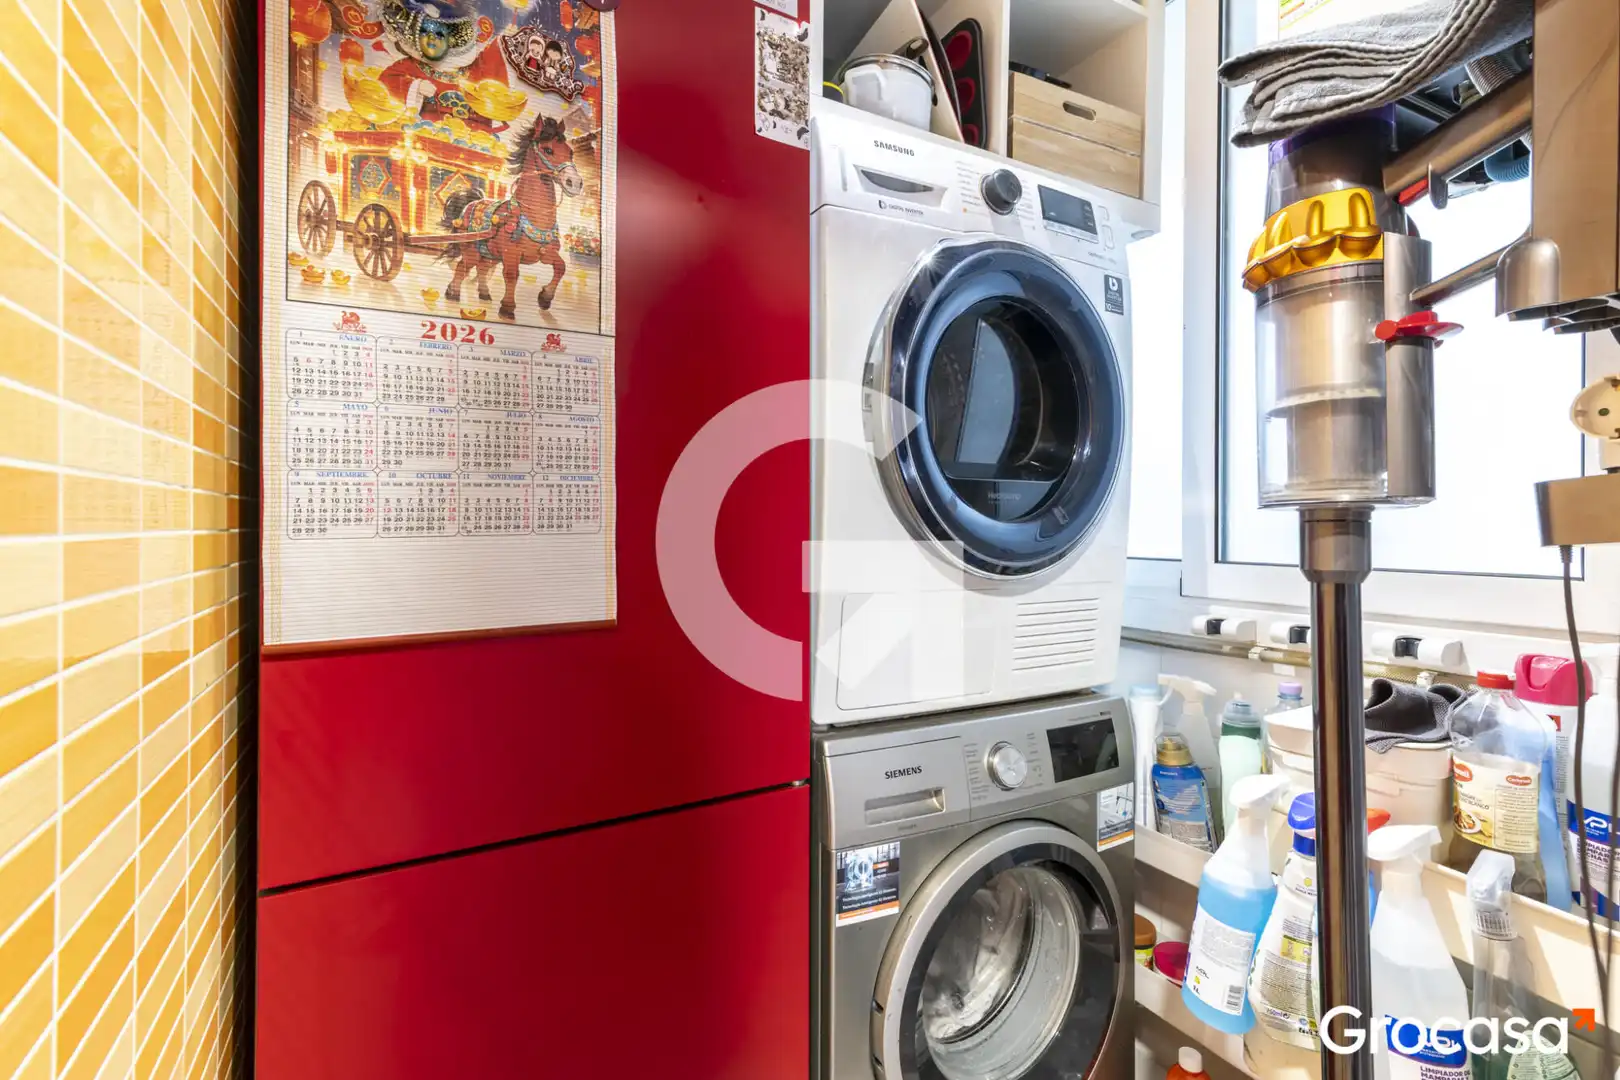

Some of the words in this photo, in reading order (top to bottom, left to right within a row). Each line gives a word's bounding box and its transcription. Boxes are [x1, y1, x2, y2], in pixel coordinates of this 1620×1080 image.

[874, 140, 915, 157] SAMSUNG
[421, 320, 495, 345] 2026
[884, 765, 923, 780] SIEMENS
[1420, 1065, 1463, 1078] LIMPIADOR
